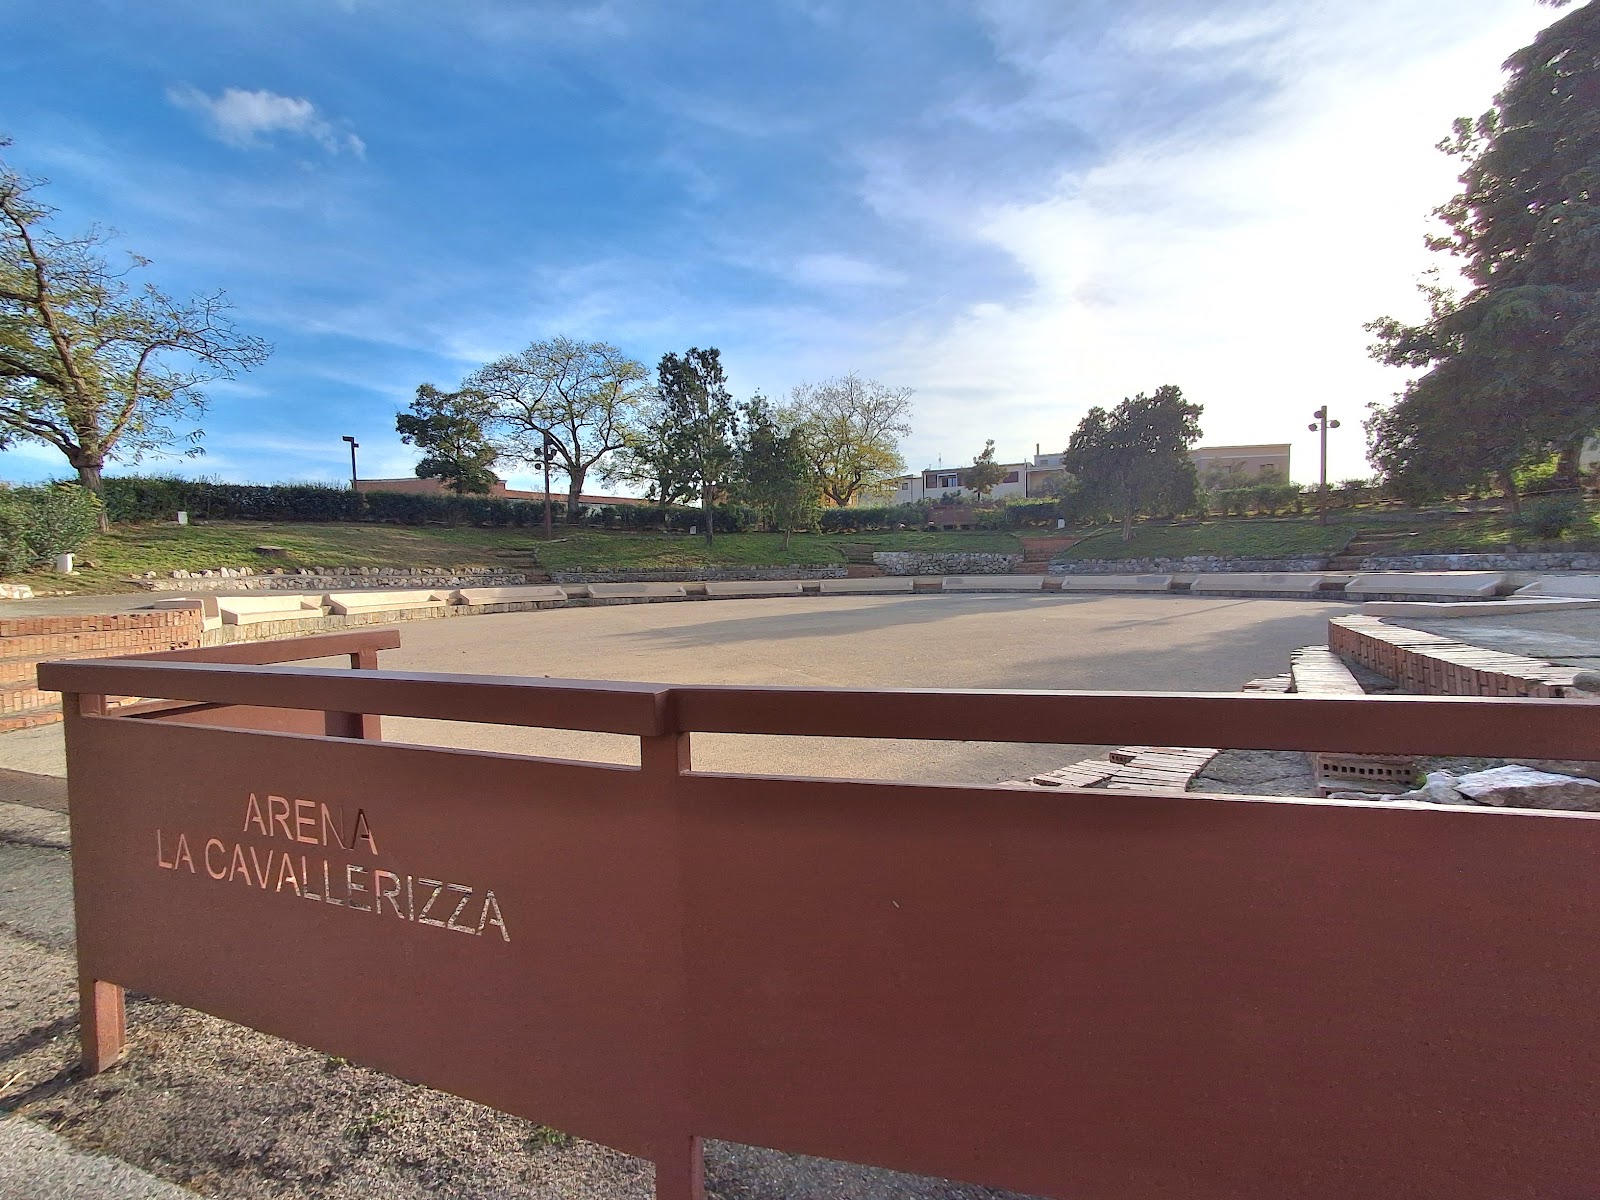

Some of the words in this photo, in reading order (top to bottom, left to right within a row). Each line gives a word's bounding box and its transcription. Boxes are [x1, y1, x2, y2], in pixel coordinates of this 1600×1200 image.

[243, 793, 378, 855] ARENA
[157, 829, 195, 873] LA
[205, 838, 511, 942] CAVALLERIZZA
